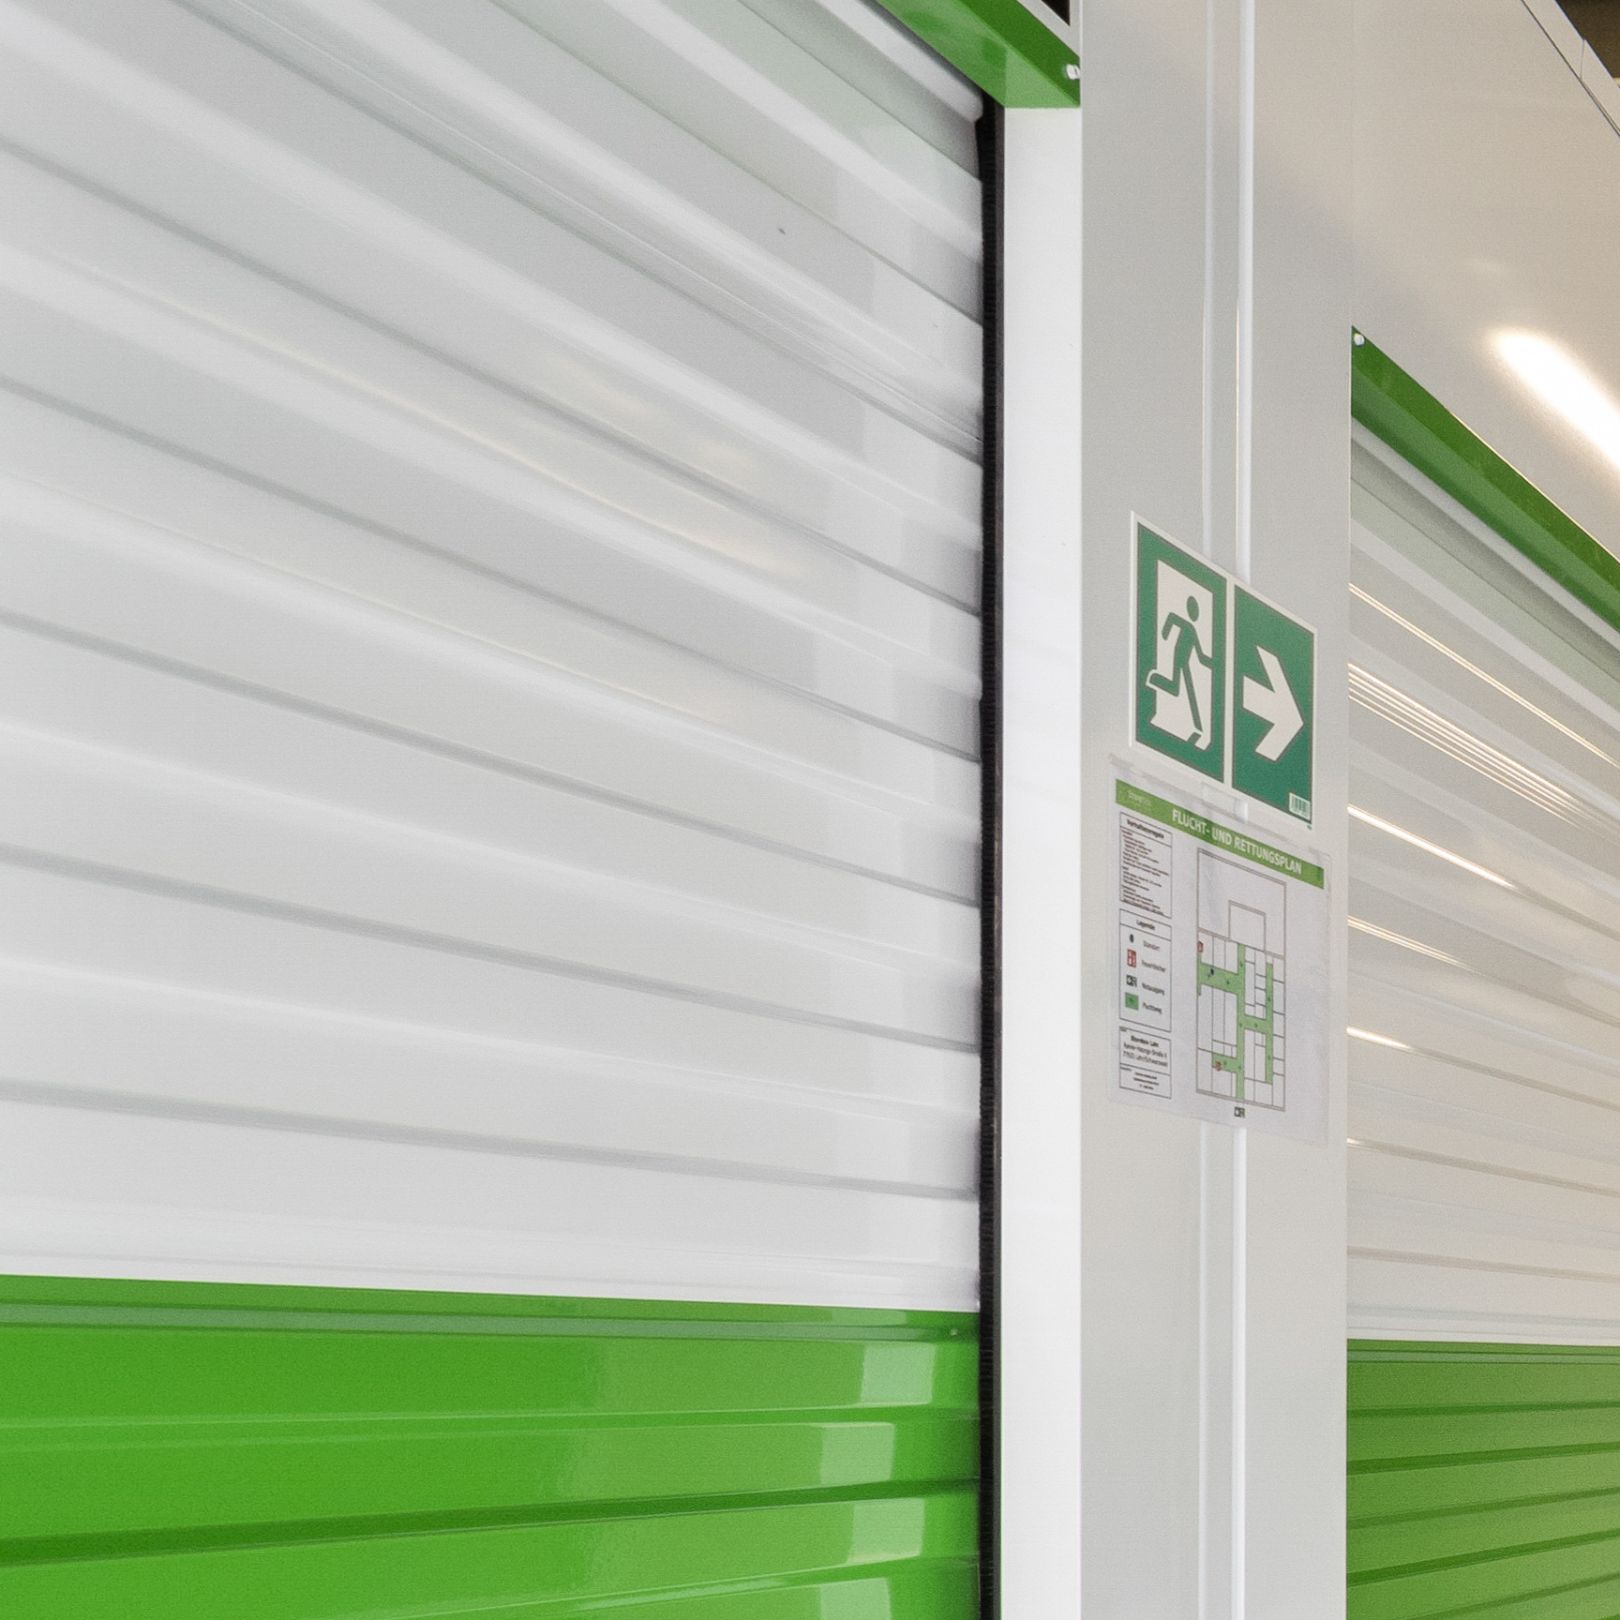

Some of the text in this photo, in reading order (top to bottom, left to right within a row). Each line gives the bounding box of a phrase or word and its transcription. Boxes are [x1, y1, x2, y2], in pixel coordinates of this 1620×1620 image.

[1171, 808, 1302, 875] FLUCHT- UND RETTUNGSPLAN
